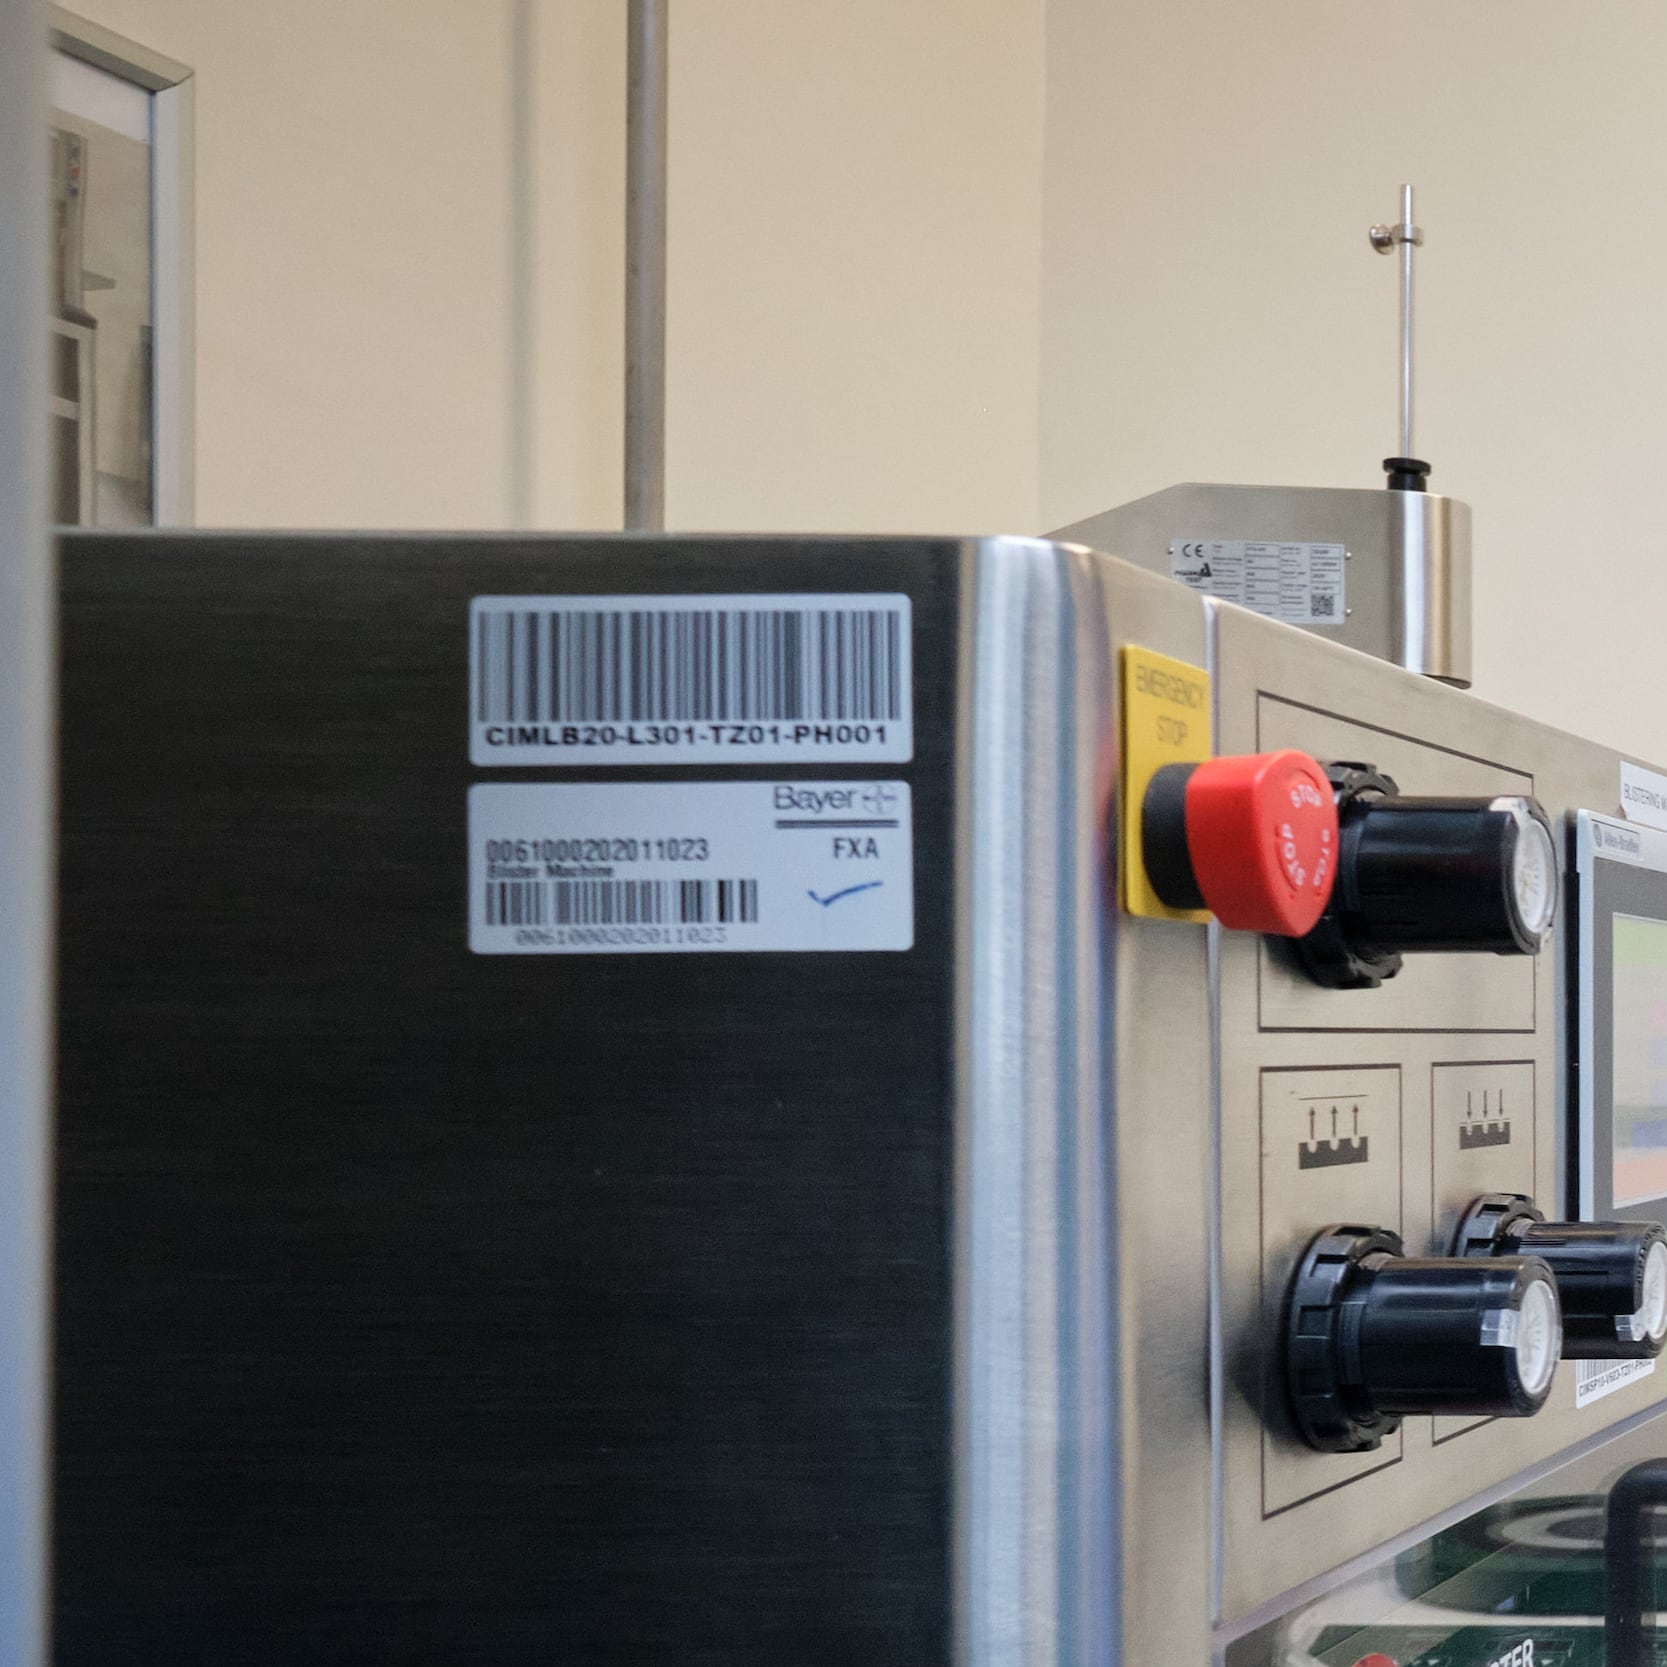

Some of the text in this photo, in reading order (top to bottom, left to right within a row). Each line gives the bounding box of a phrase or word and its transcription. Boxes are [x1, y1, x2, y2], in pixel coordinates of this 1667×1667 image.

[486, 725, 887, 746] CIMLB20-L301-TZ01-PH001
[773, 785, 857, 813] Bayer
[832, 837, 880, 860] FXA
